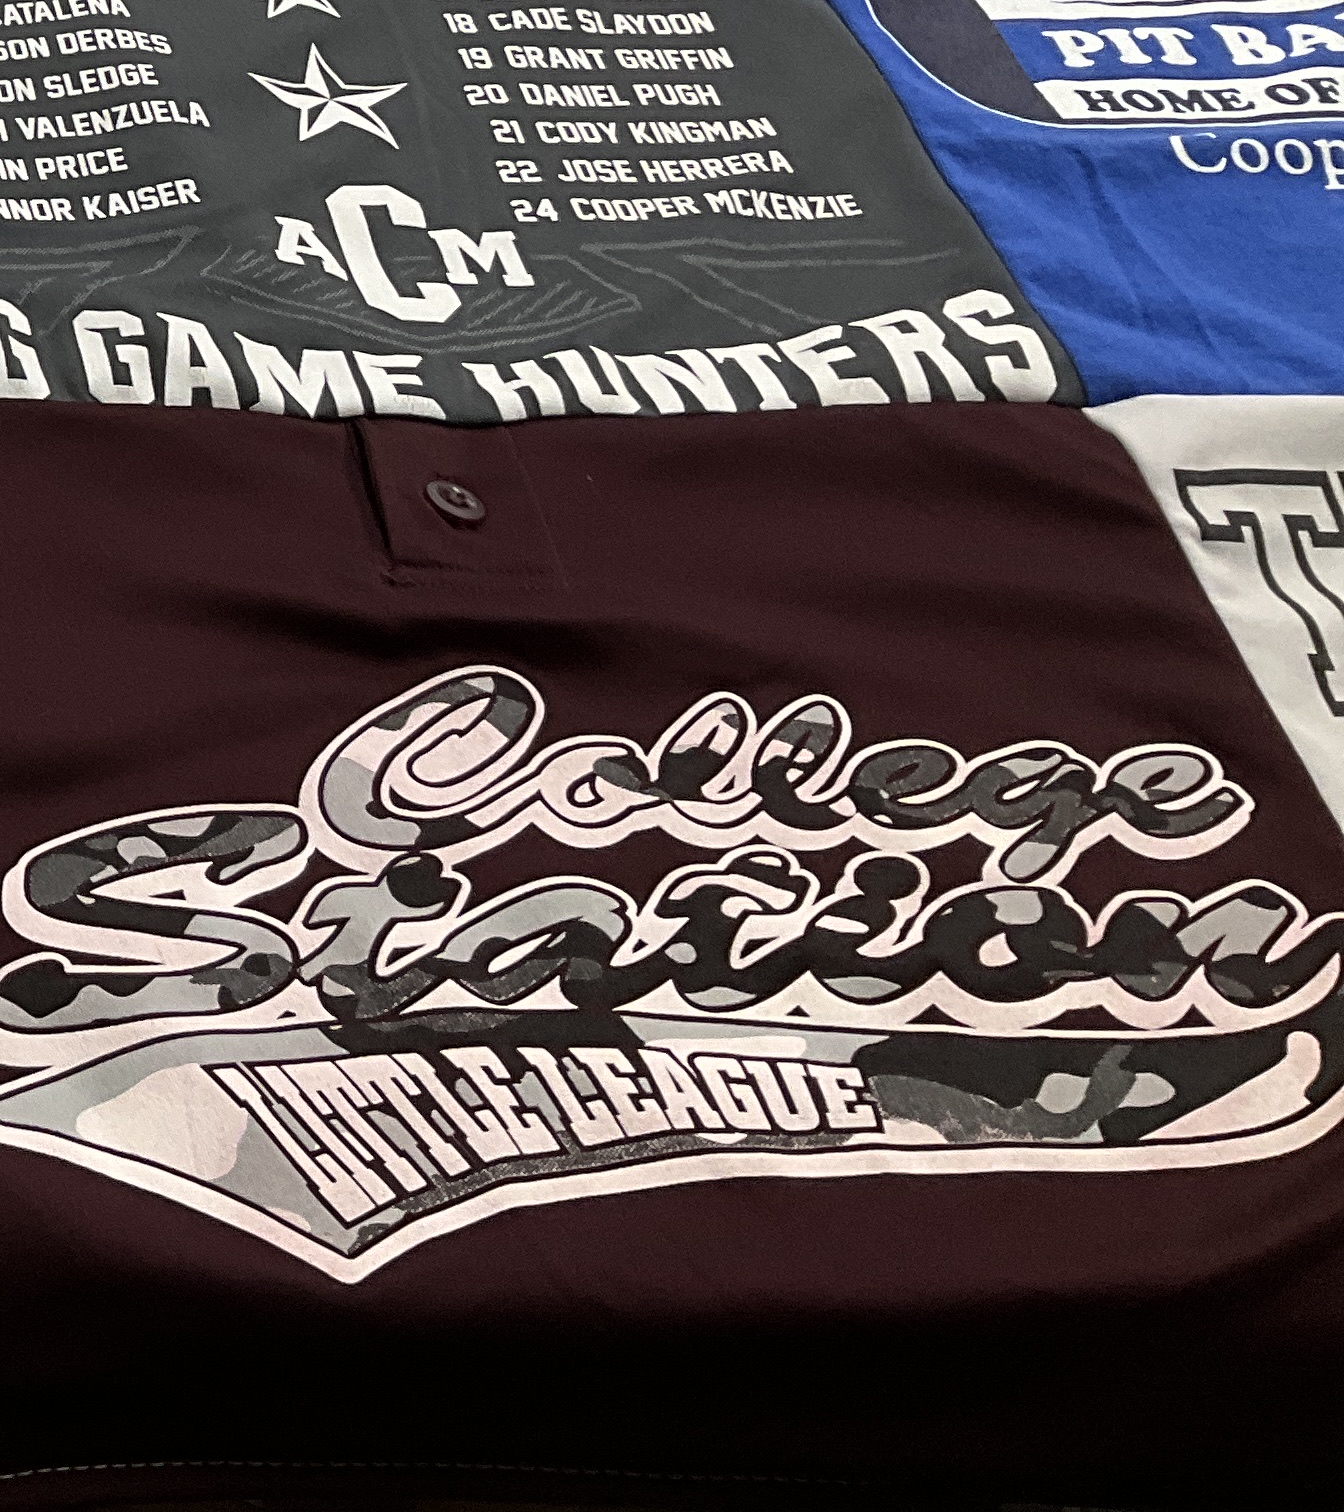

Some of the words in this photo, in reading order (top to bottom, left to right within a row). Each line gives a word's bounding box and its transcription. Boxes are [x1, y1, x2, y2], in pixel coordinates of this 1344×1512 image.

[458, 47, 492, 70] 19
[504, 46, 606, 71] GRANT
[614, 47, 734, 71] GRIFFIN
[1041, 25, 1199, 69] PIT
[1072, 89, 1256, 115] HOME
[1265, 76, 1342, 107] OF
[16, 100, 210, 142] VALENZUELA
[510, 198, 558, 223] 24
[571, 195, 701, 222] COOPER
[706, 189, 864, 222] MCKENZIE
[68, 307, 454, 421] GAME
[460, 287, 1060, 421] HUNTERS
[298, 664, 1257, 904] College
[212, 1045, 562, 1224] LITTLE
[516, 1044, 884, 1154] LEAGUE
